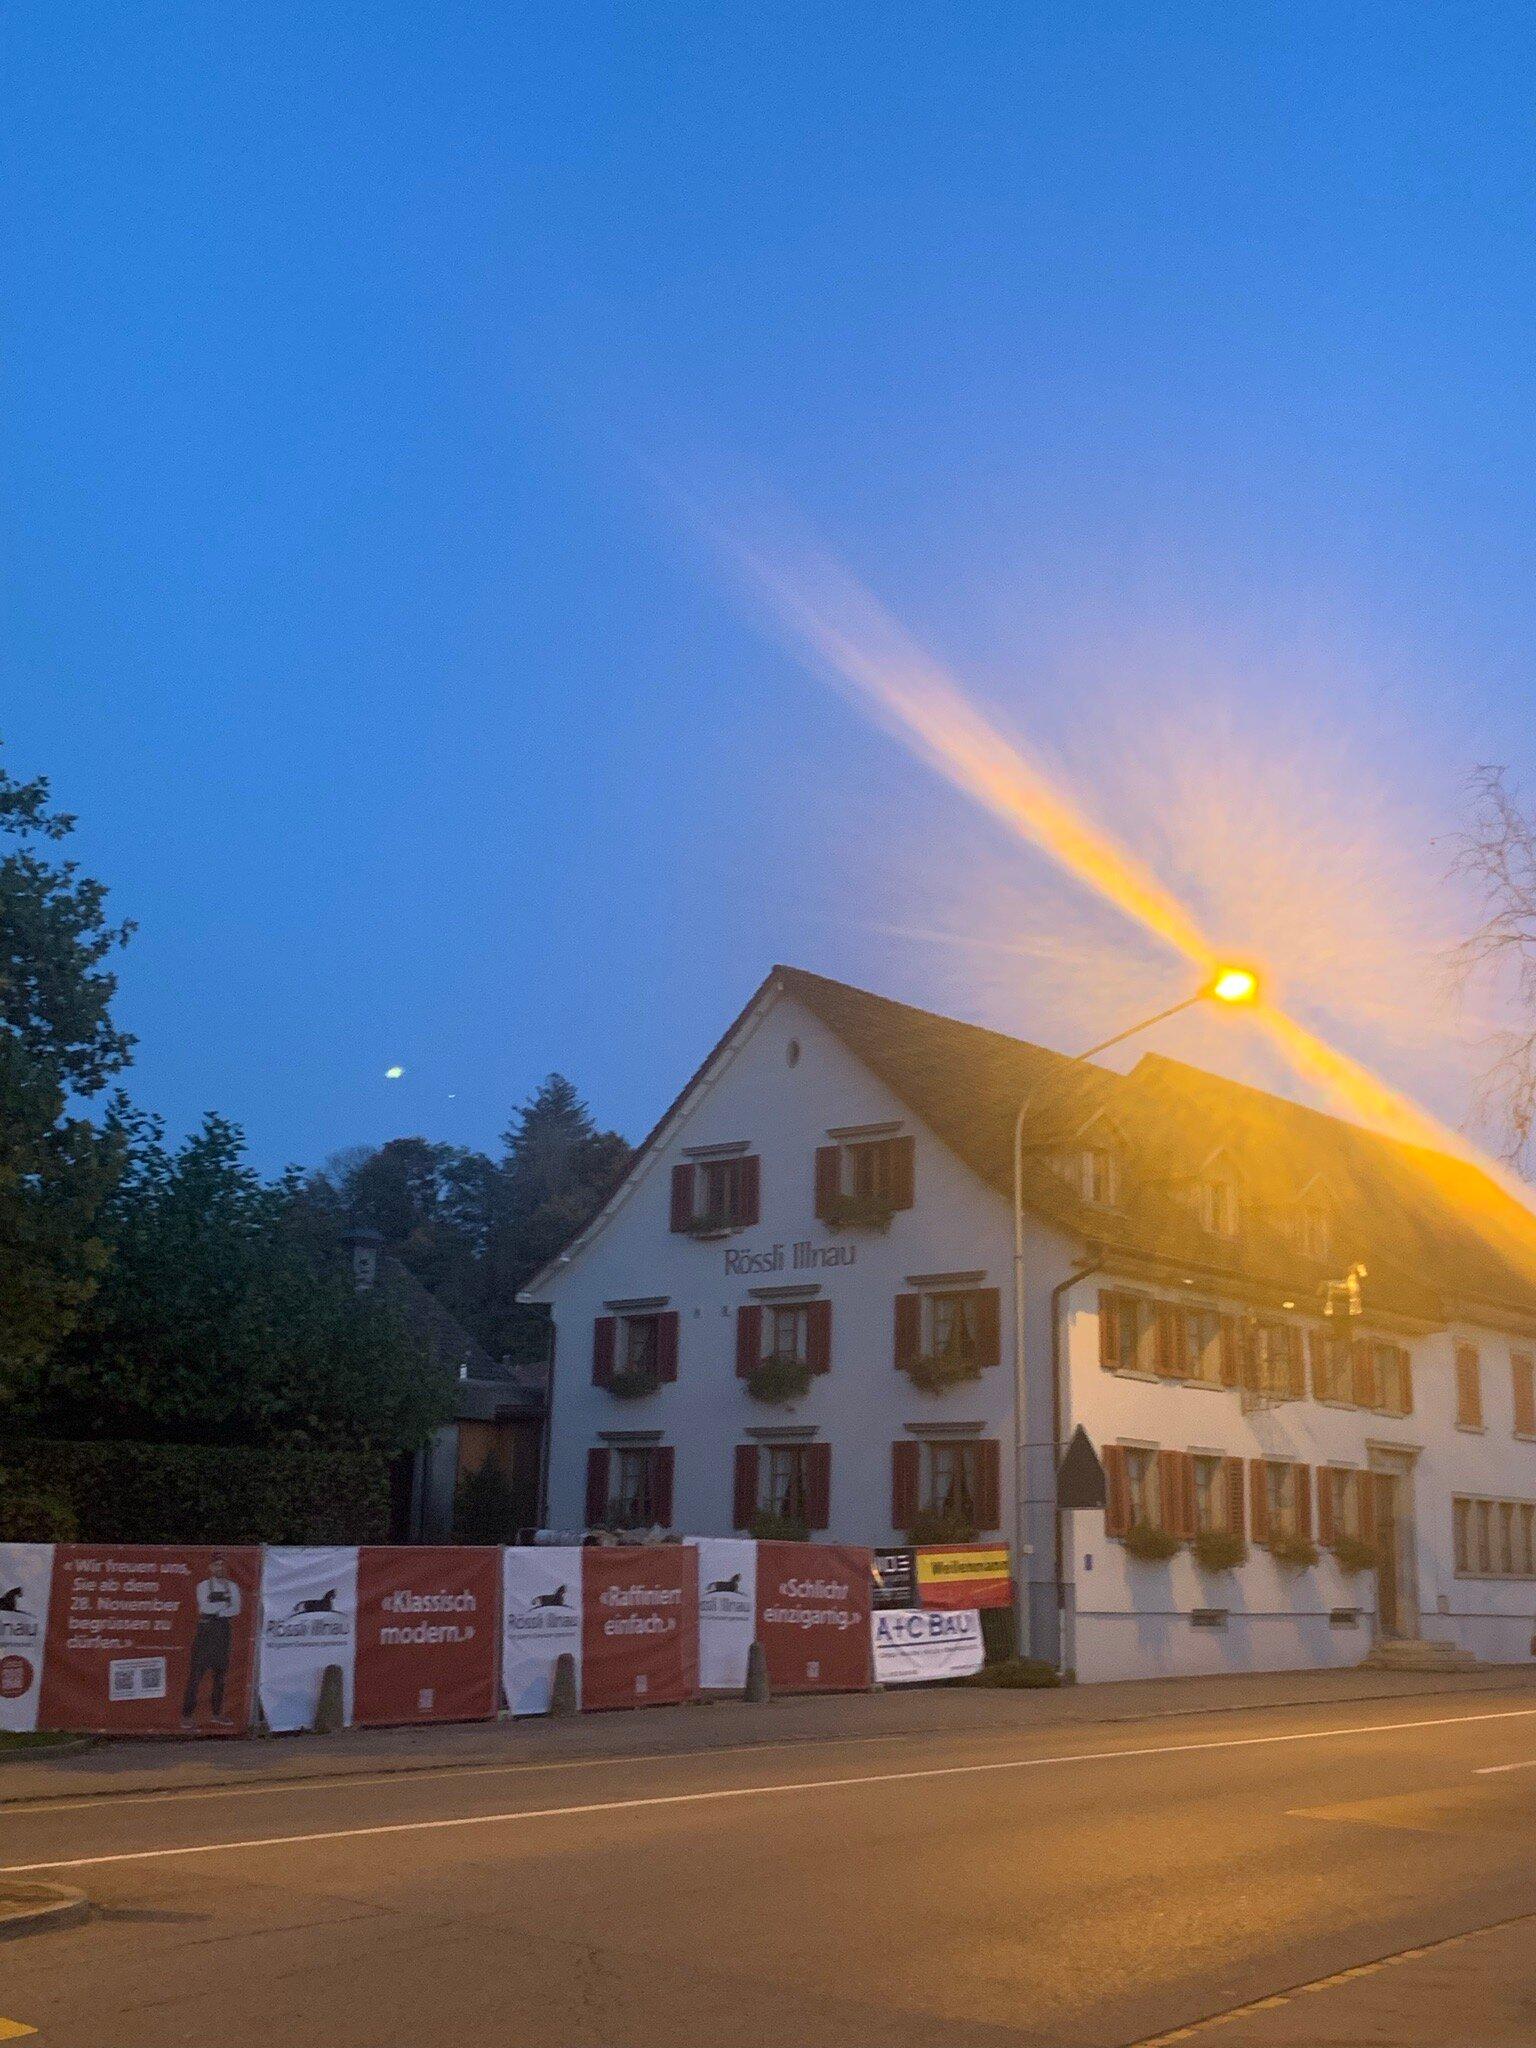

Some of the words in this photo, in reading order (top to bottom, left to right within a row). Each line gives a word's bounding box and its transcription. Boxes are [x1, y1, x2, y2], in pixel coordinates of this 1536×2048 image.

[725, 1243, 785, 1275] Rössli
[793, 1241, 856, 1270] Illnau
[72, 1577, 97, 1591] Sie
[99, 1578, 121, 1592] ab
[97, 1597, 181, 1612] November
[381, 1588, 477, 1613] «Klassisch
[929, 1613, 973, 1637] BAU
